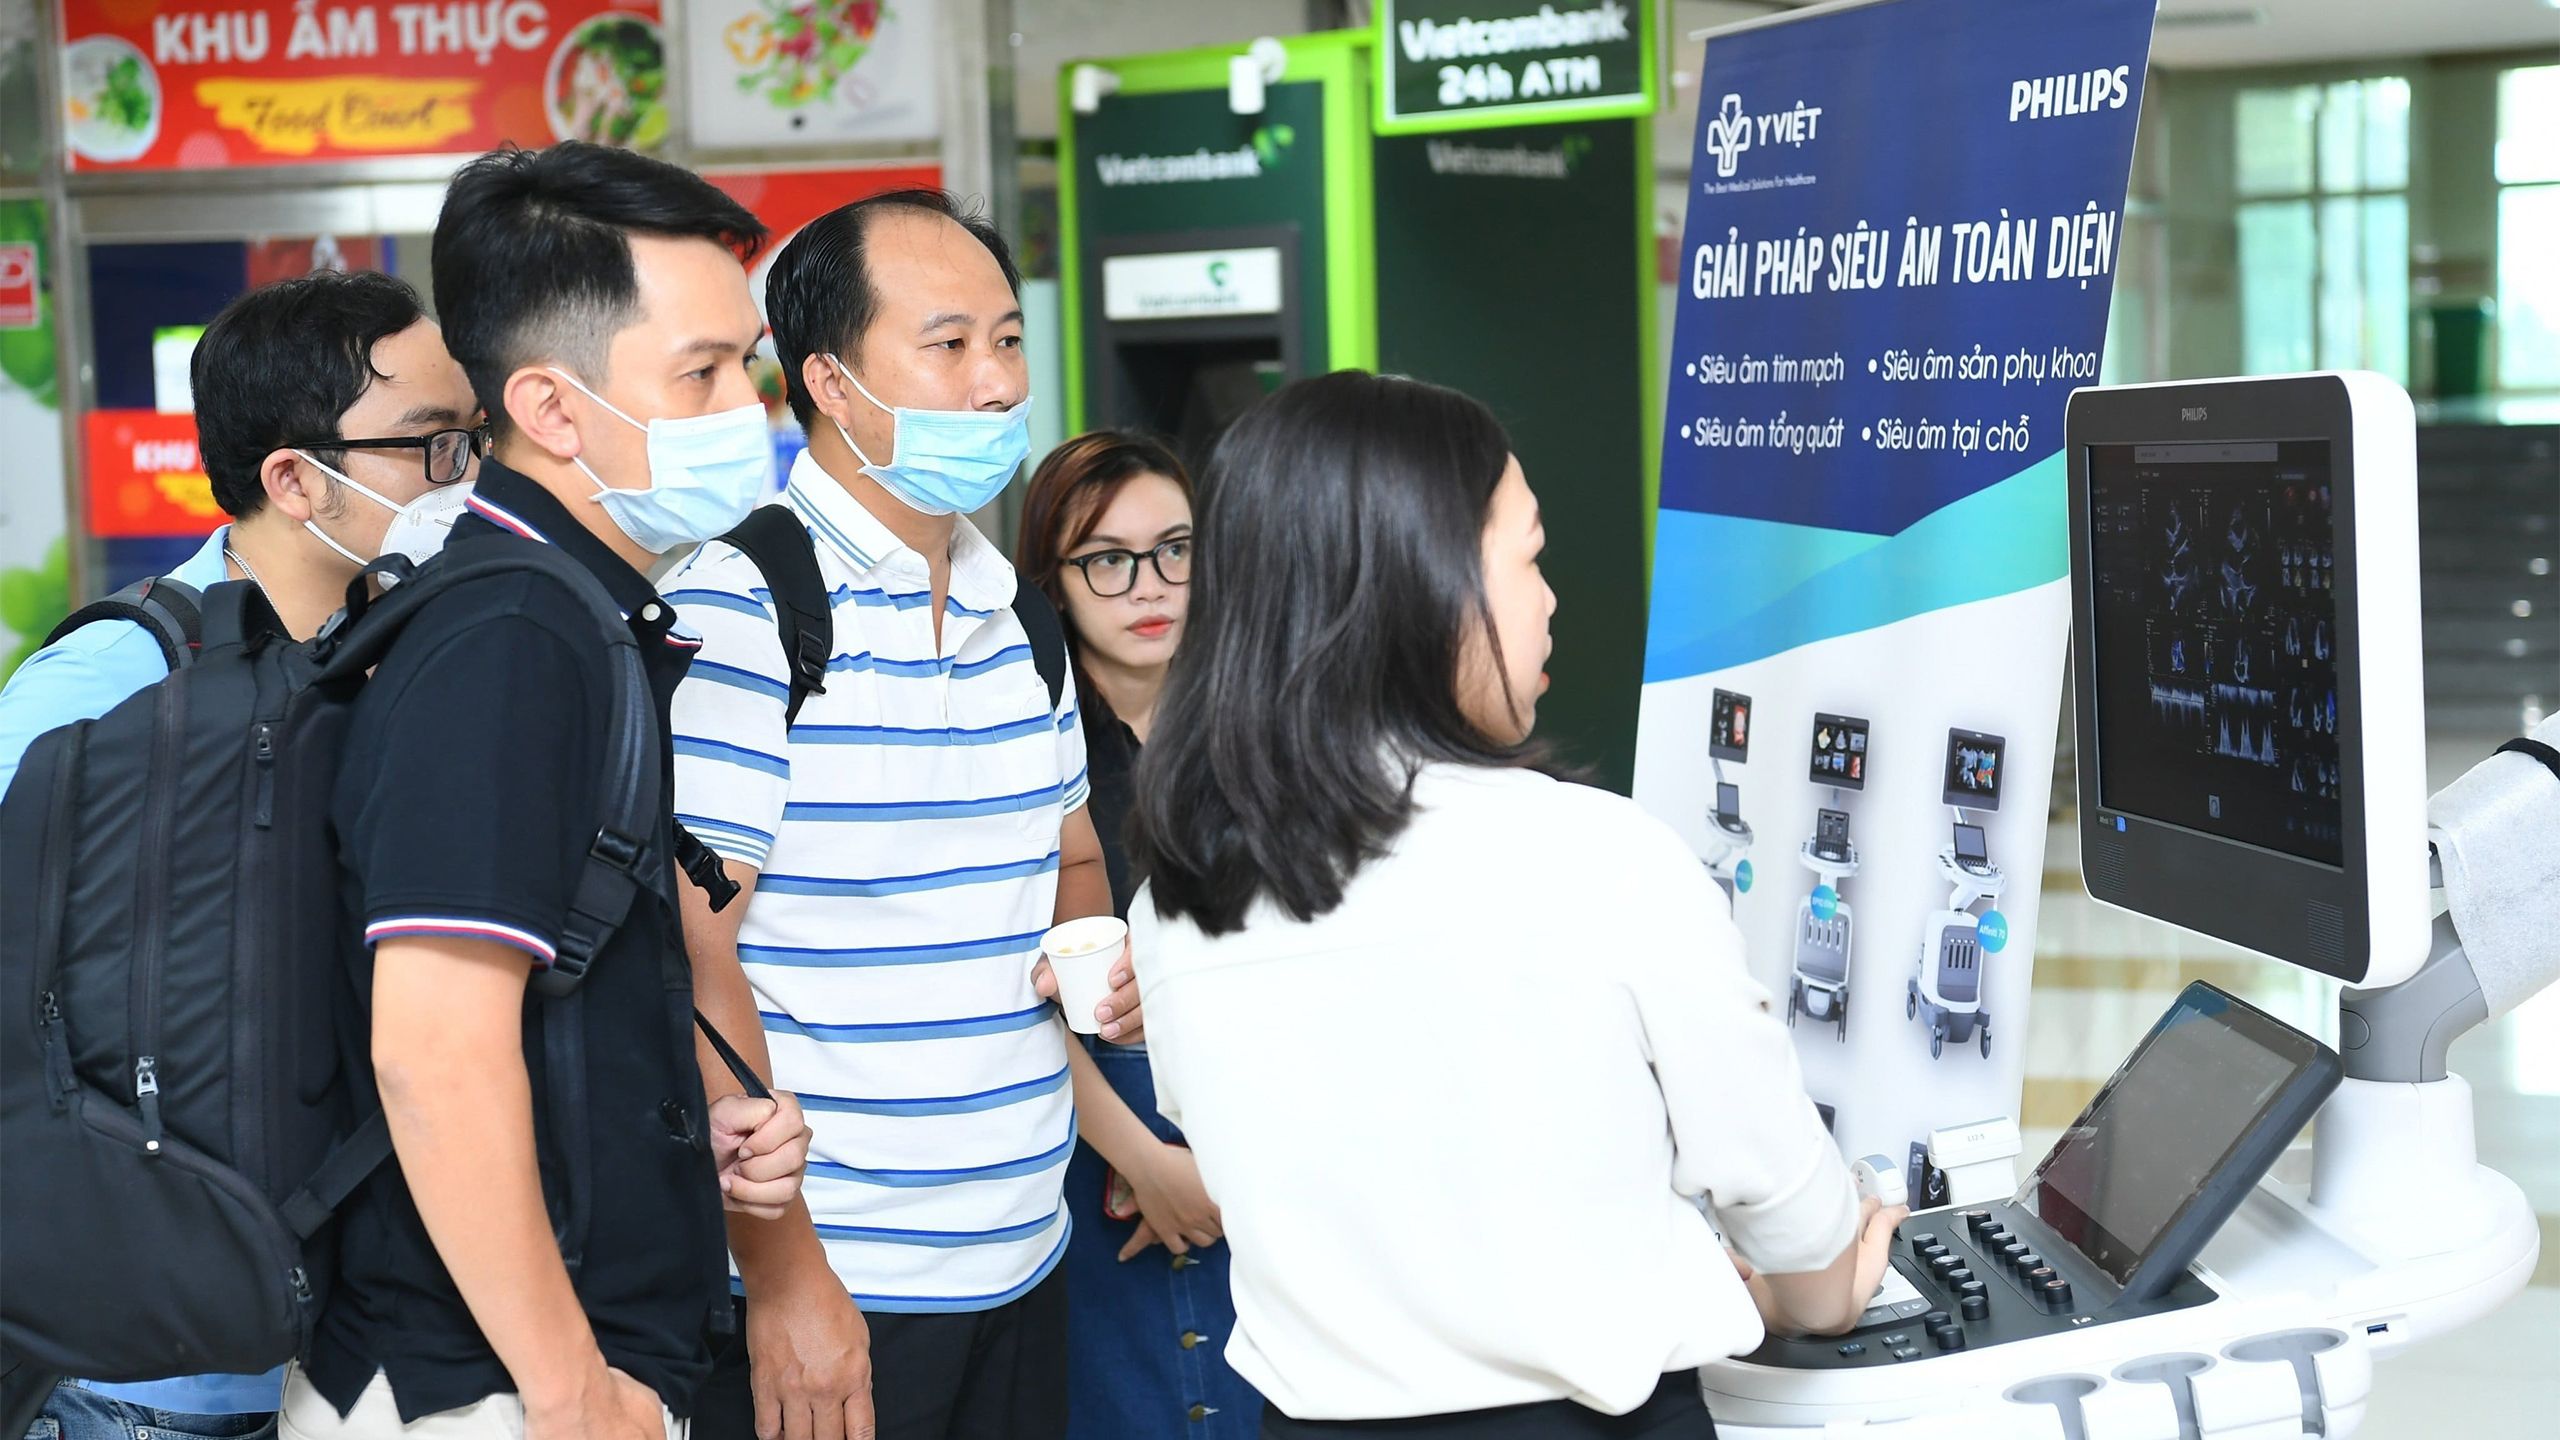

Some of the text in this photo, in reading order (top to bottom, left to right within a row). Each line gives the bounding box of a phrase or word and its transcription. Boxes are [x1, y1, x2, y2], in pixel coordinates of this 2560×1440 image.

[153, 11, 269, 65] KHU
[391, 2, 549, 66] THỰC
[1400, 0, 1630, 62] Vietcombank
[1438, 55, 1602, 106] 24h ATM
[2009, 65, 2129, 122] PHILIPS
[1096, 144, 1263, 186] Vietcombank
[1693, 200, 2116, 299] GIẢI PHÁP SIÊU ÂM TOÀN DIỆN
[1699, 351, 1845, 388] Siêu âm tim mạch
[1882, 343, 2097, 387] Siêu âm sản phụ khoa
[1694, 410, 1846, 456] Siêu âm tổng quát
[1875, 414, 2030, 458] Siêu âm tại chỗ
[2181, 407, 2208, 422] PHILIPS
